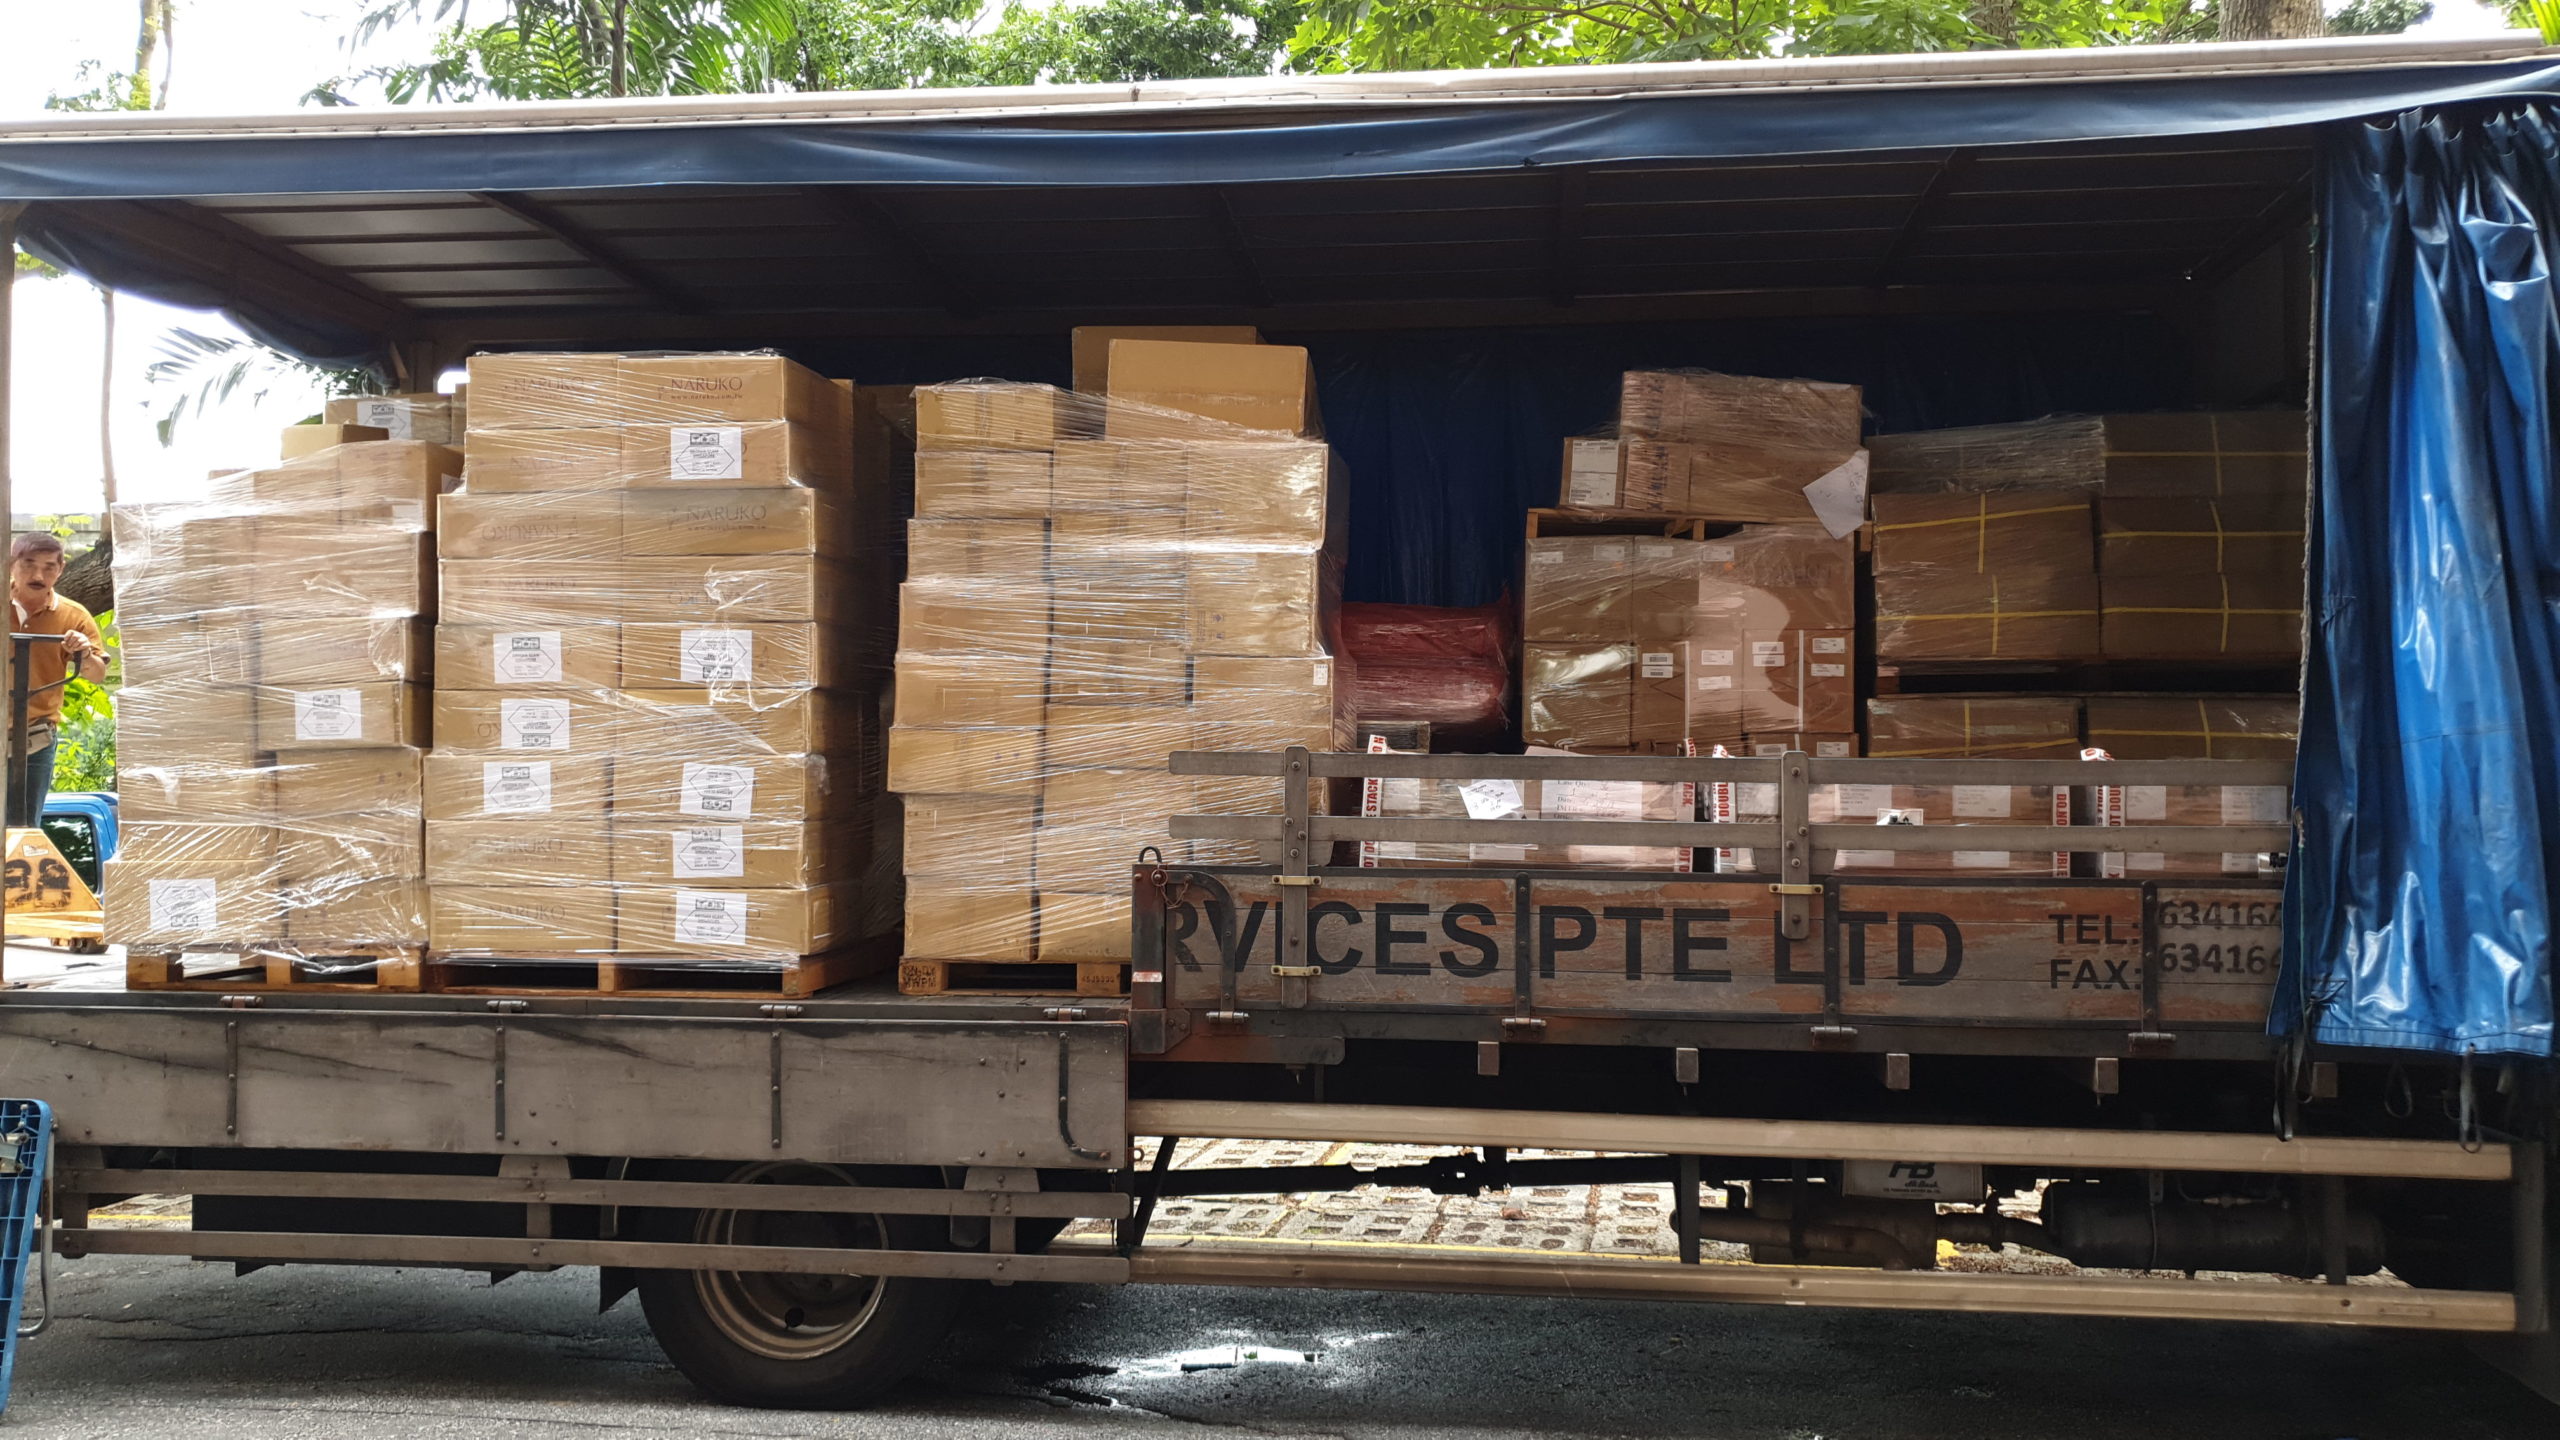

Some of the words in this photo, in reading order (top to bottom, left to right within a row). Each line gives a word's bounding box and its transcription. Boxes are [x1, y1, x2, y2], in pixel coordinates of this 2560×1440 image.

[671, 377, 743, 391] NARUKO
[687, 504, 767, 521] NARUKO
[1366, 778, 1378, 812] STACK
[1683, 784, 1694, 806] ACK
[2048, 914, 2139, 945] TEL:
[1540, 905, 1732, 983] PTE
[1774, 911, 1963, 987] LTD
[2050, 958, 2142, 990] FAX:
